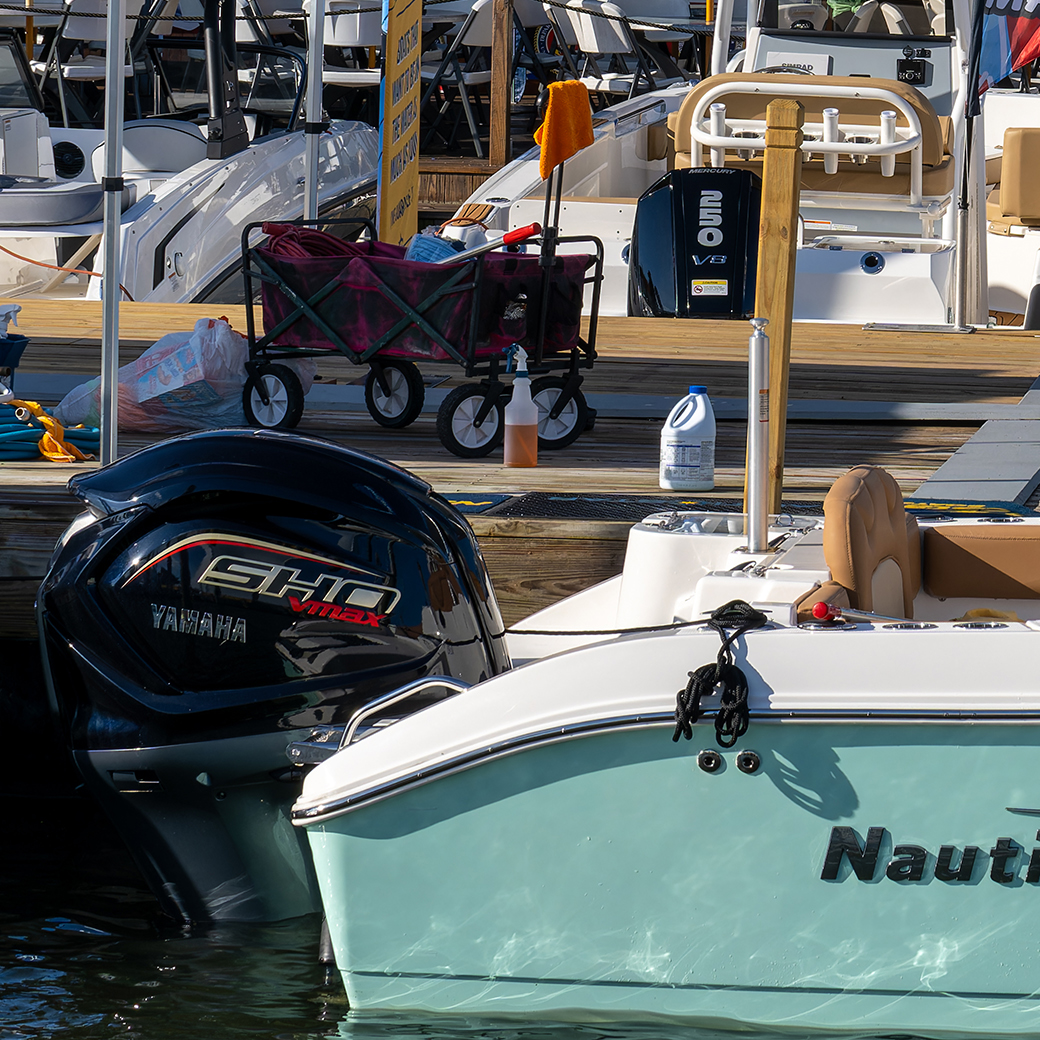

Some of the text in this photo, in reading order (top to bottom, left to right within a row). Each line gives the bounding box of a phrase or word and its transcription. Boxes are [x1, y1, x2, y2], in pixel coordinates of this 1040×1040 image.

[697, 189, 724, 248] 250
[691, 254, 728, 266] V8
[197, 554, 401, 614] SHO
[150, 603, 247, 644] YAMAHA
